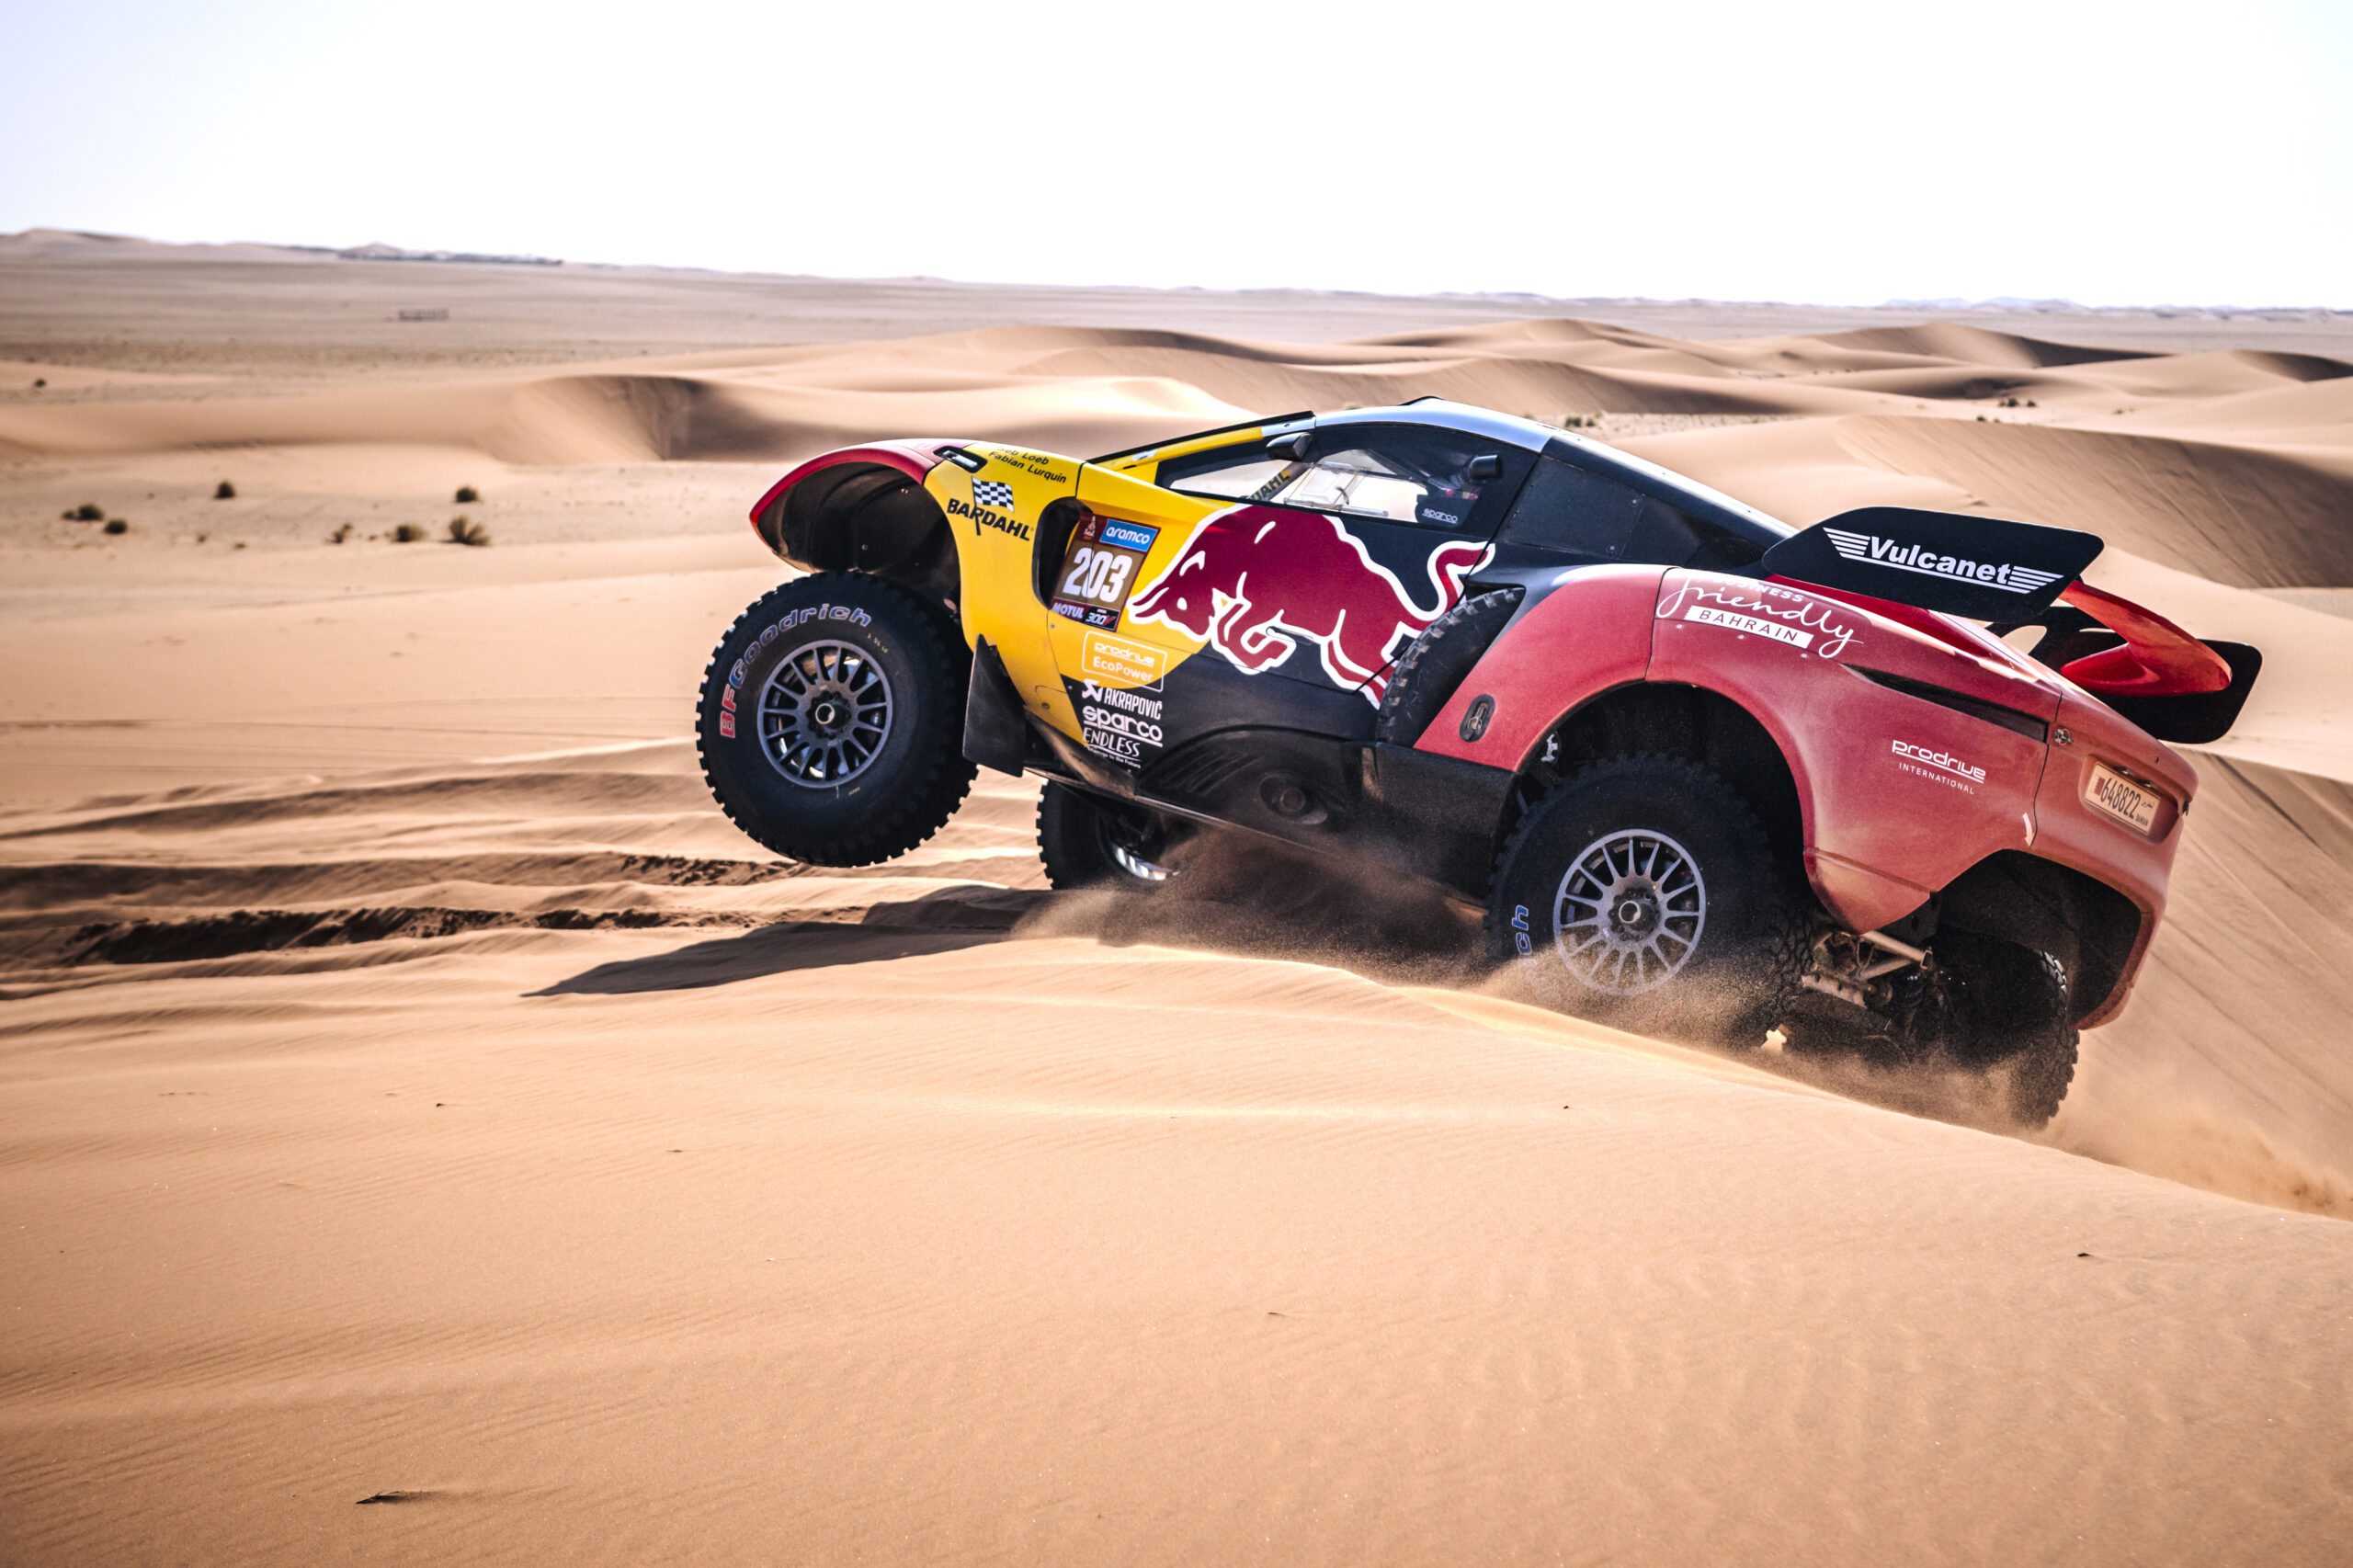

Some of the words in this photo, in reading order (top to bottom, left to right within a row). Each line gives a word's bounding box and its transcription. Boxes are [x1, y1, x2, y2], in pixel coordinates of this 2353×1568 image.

[988, 450, 1025, 469] Fabian
[1027, 464, 1066, 483] Lurquin
[1022, 452, 1049, 465] Loeb
[947, 497, 1030, 542] BARDAHL
[1423, 508, 1459, 524] sparco
[1106, 527, 1151, 544] aramco
[1063, 547, 1133, 603] 203
[1870, 536, 2012, 585] Vulcanet
[1051, 602, 1085, 619] MOTUL
[1656, 577, 1865, 659] friendly
[1699, 609, 1799, 642] BAHRAIN
[721, 603, 871, 738] BFGoodrich
[1093, 656, 1154, 683] EcoPower
[1083, 705, 1163, 744] sparco
[1083, 727, 1141, 757] ENDLESS
[1899, 762, 1974, 795] INTERNATIONAL
[2100, 778, 2142, 819] 648822
